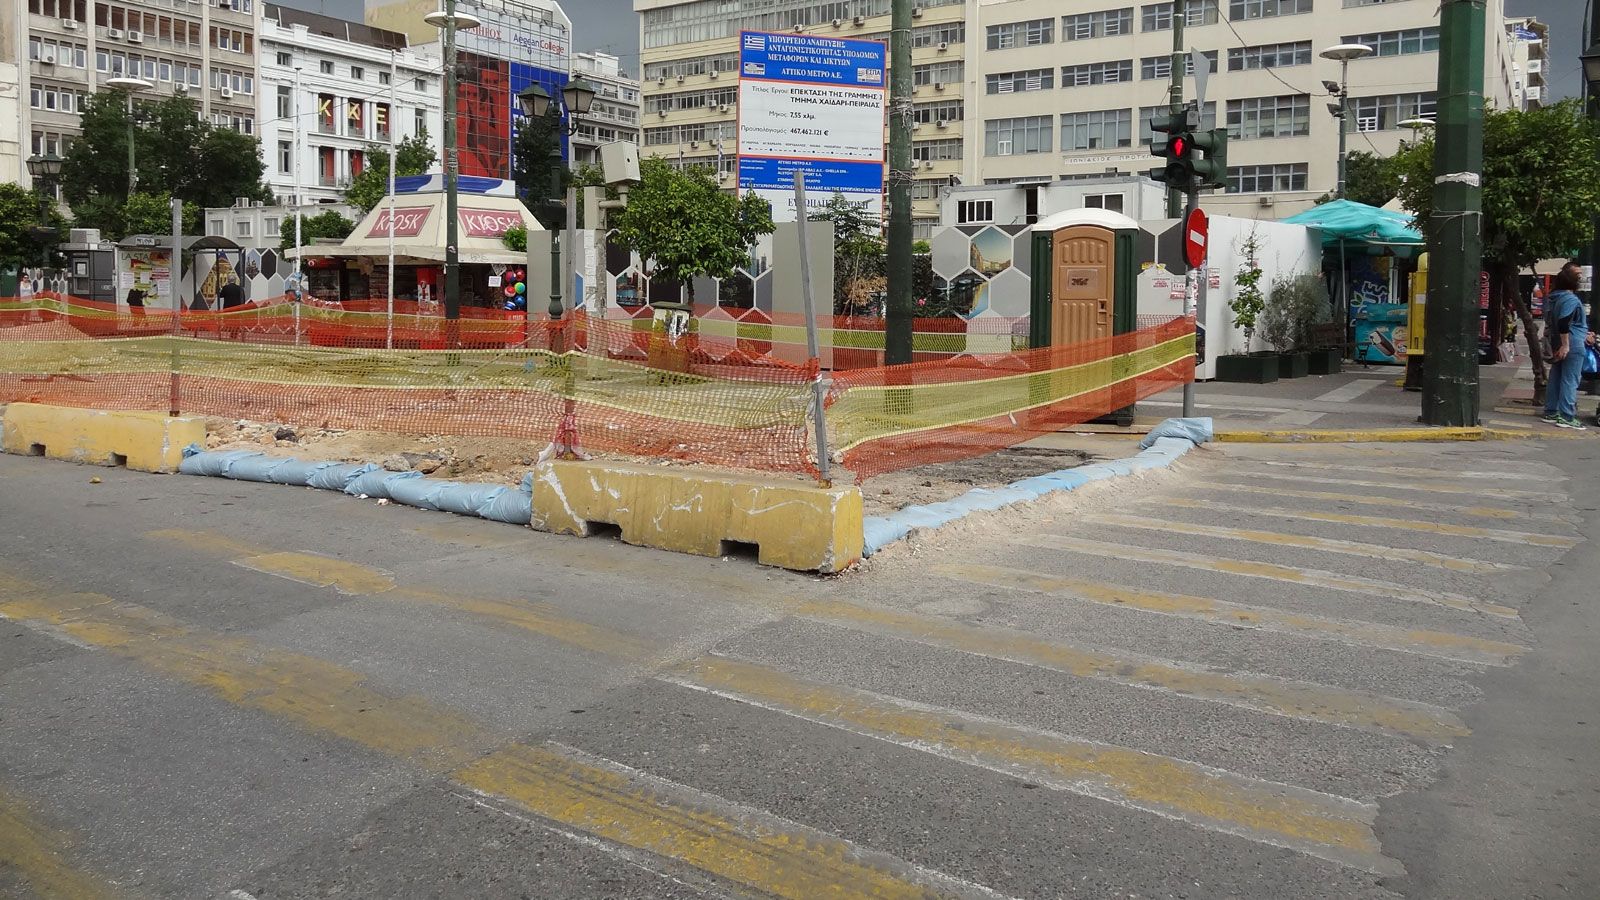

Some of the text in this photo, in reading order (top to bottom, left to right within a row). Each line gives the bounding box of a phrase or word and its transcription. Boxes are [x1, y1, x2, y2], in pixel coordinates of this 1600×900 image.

[768, 35, 846, 48] ΥΠΟΥΡΓΕΙΟ ΑΝΑΠΤΥΞΗΣ
[767, 44, 879, 59] ΑΝΤΑΓΩΝΙΣΤΙΚΟΤΗΤΑΣ ΥΠΟΔΟΜΩΝ
[767, 53, 851, 66] ΜΕΤΑΦΟΡΩΝ ΚΑΙ ΔΙΚΤΥΩΝ
[781, 67, 806, 76] ΑΤΤΙΚΟ
[807, 69, 830, 78] ΜΕΤΡΟ
[790, 88, 827, 96] ΕΠΕΚΤΑΣΗ
[844, 92, 878, 100] ΓΡΑΜΜΗΣ
